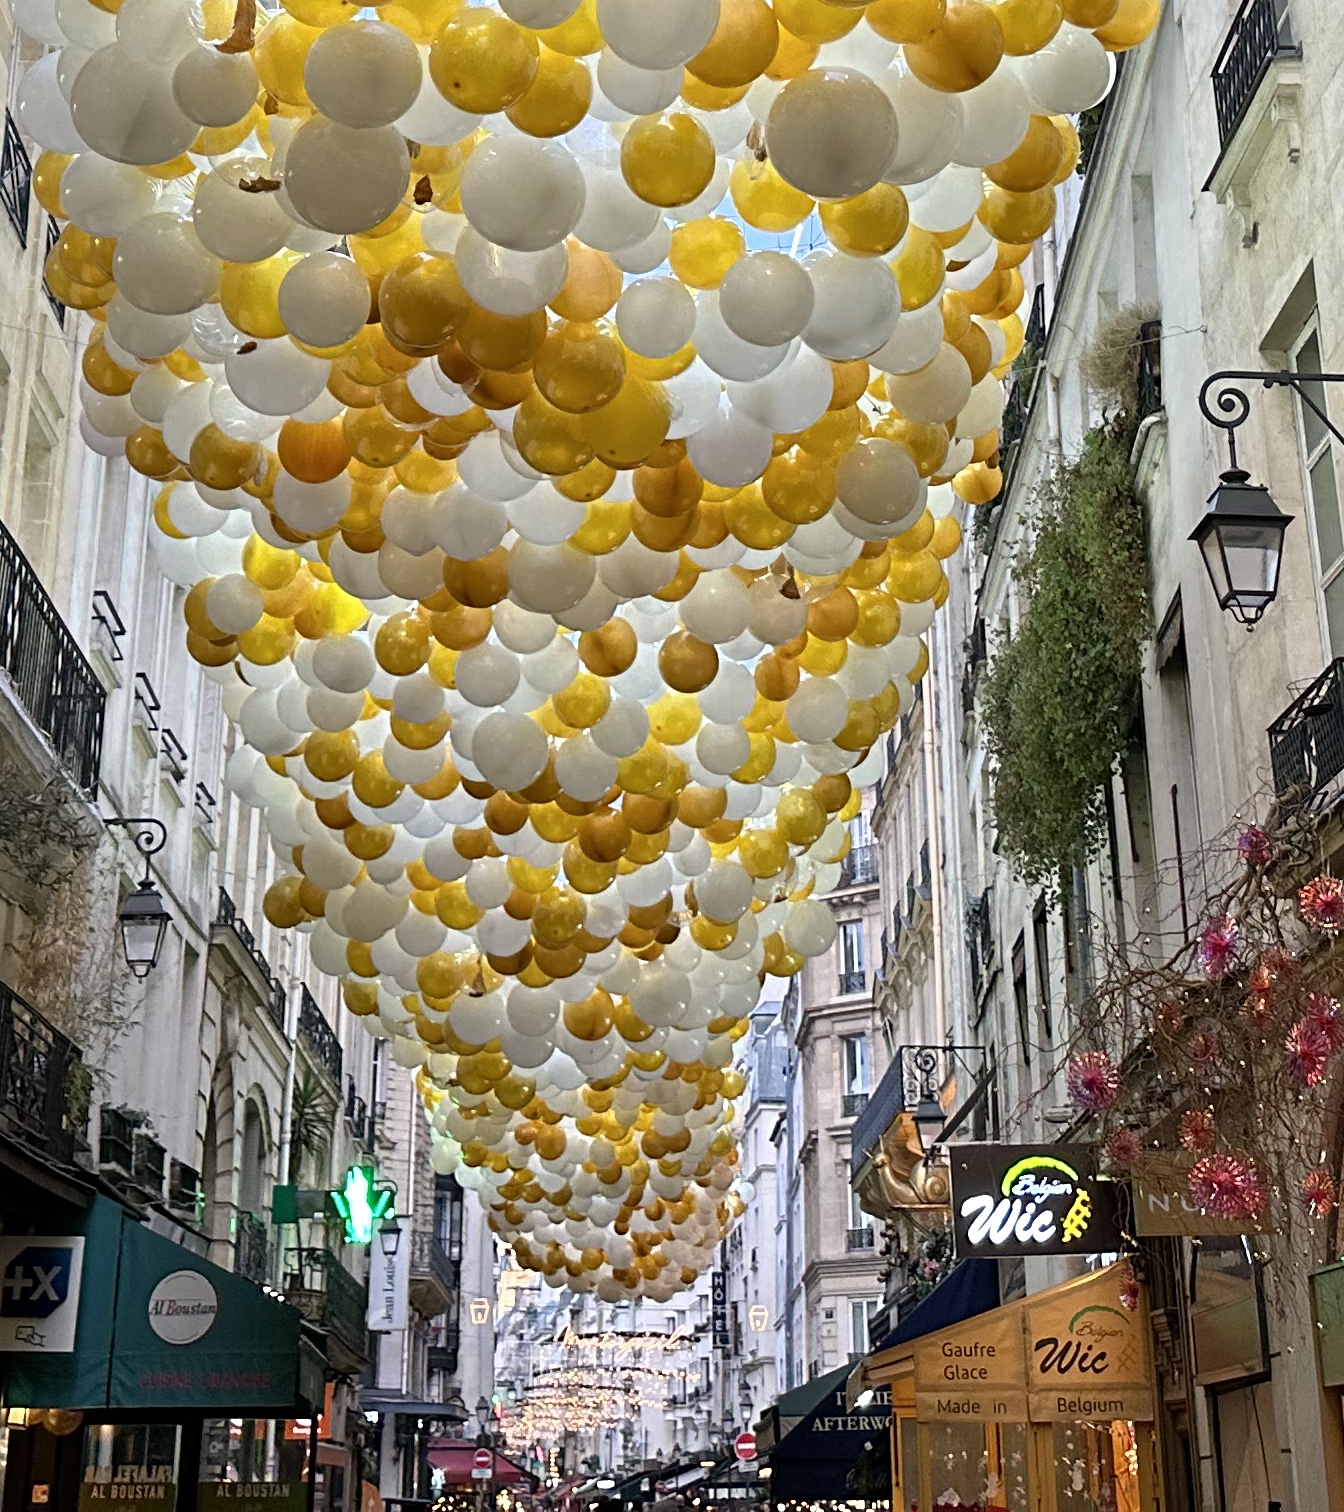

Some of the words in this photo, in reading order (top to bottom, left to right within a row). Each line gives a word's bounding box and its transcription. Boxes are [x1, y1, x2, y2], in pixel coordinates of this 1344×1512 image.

[960, 1194, 1057, 1246] Wic
[941, 1341, 997, 1359] Gaufre
[1034, 1336, 1110, 1375] Wic
[943, 1364, 989, 1380] Glace
[936, 1399, 981, 1415] Made
[992, 1399, 1007, 1414] in
[1056, 1397, 1125, 1416] Belgium
[90, 1484, 106, 1499] AL
[110, 1484, 166, 1500] BOUSTAN
